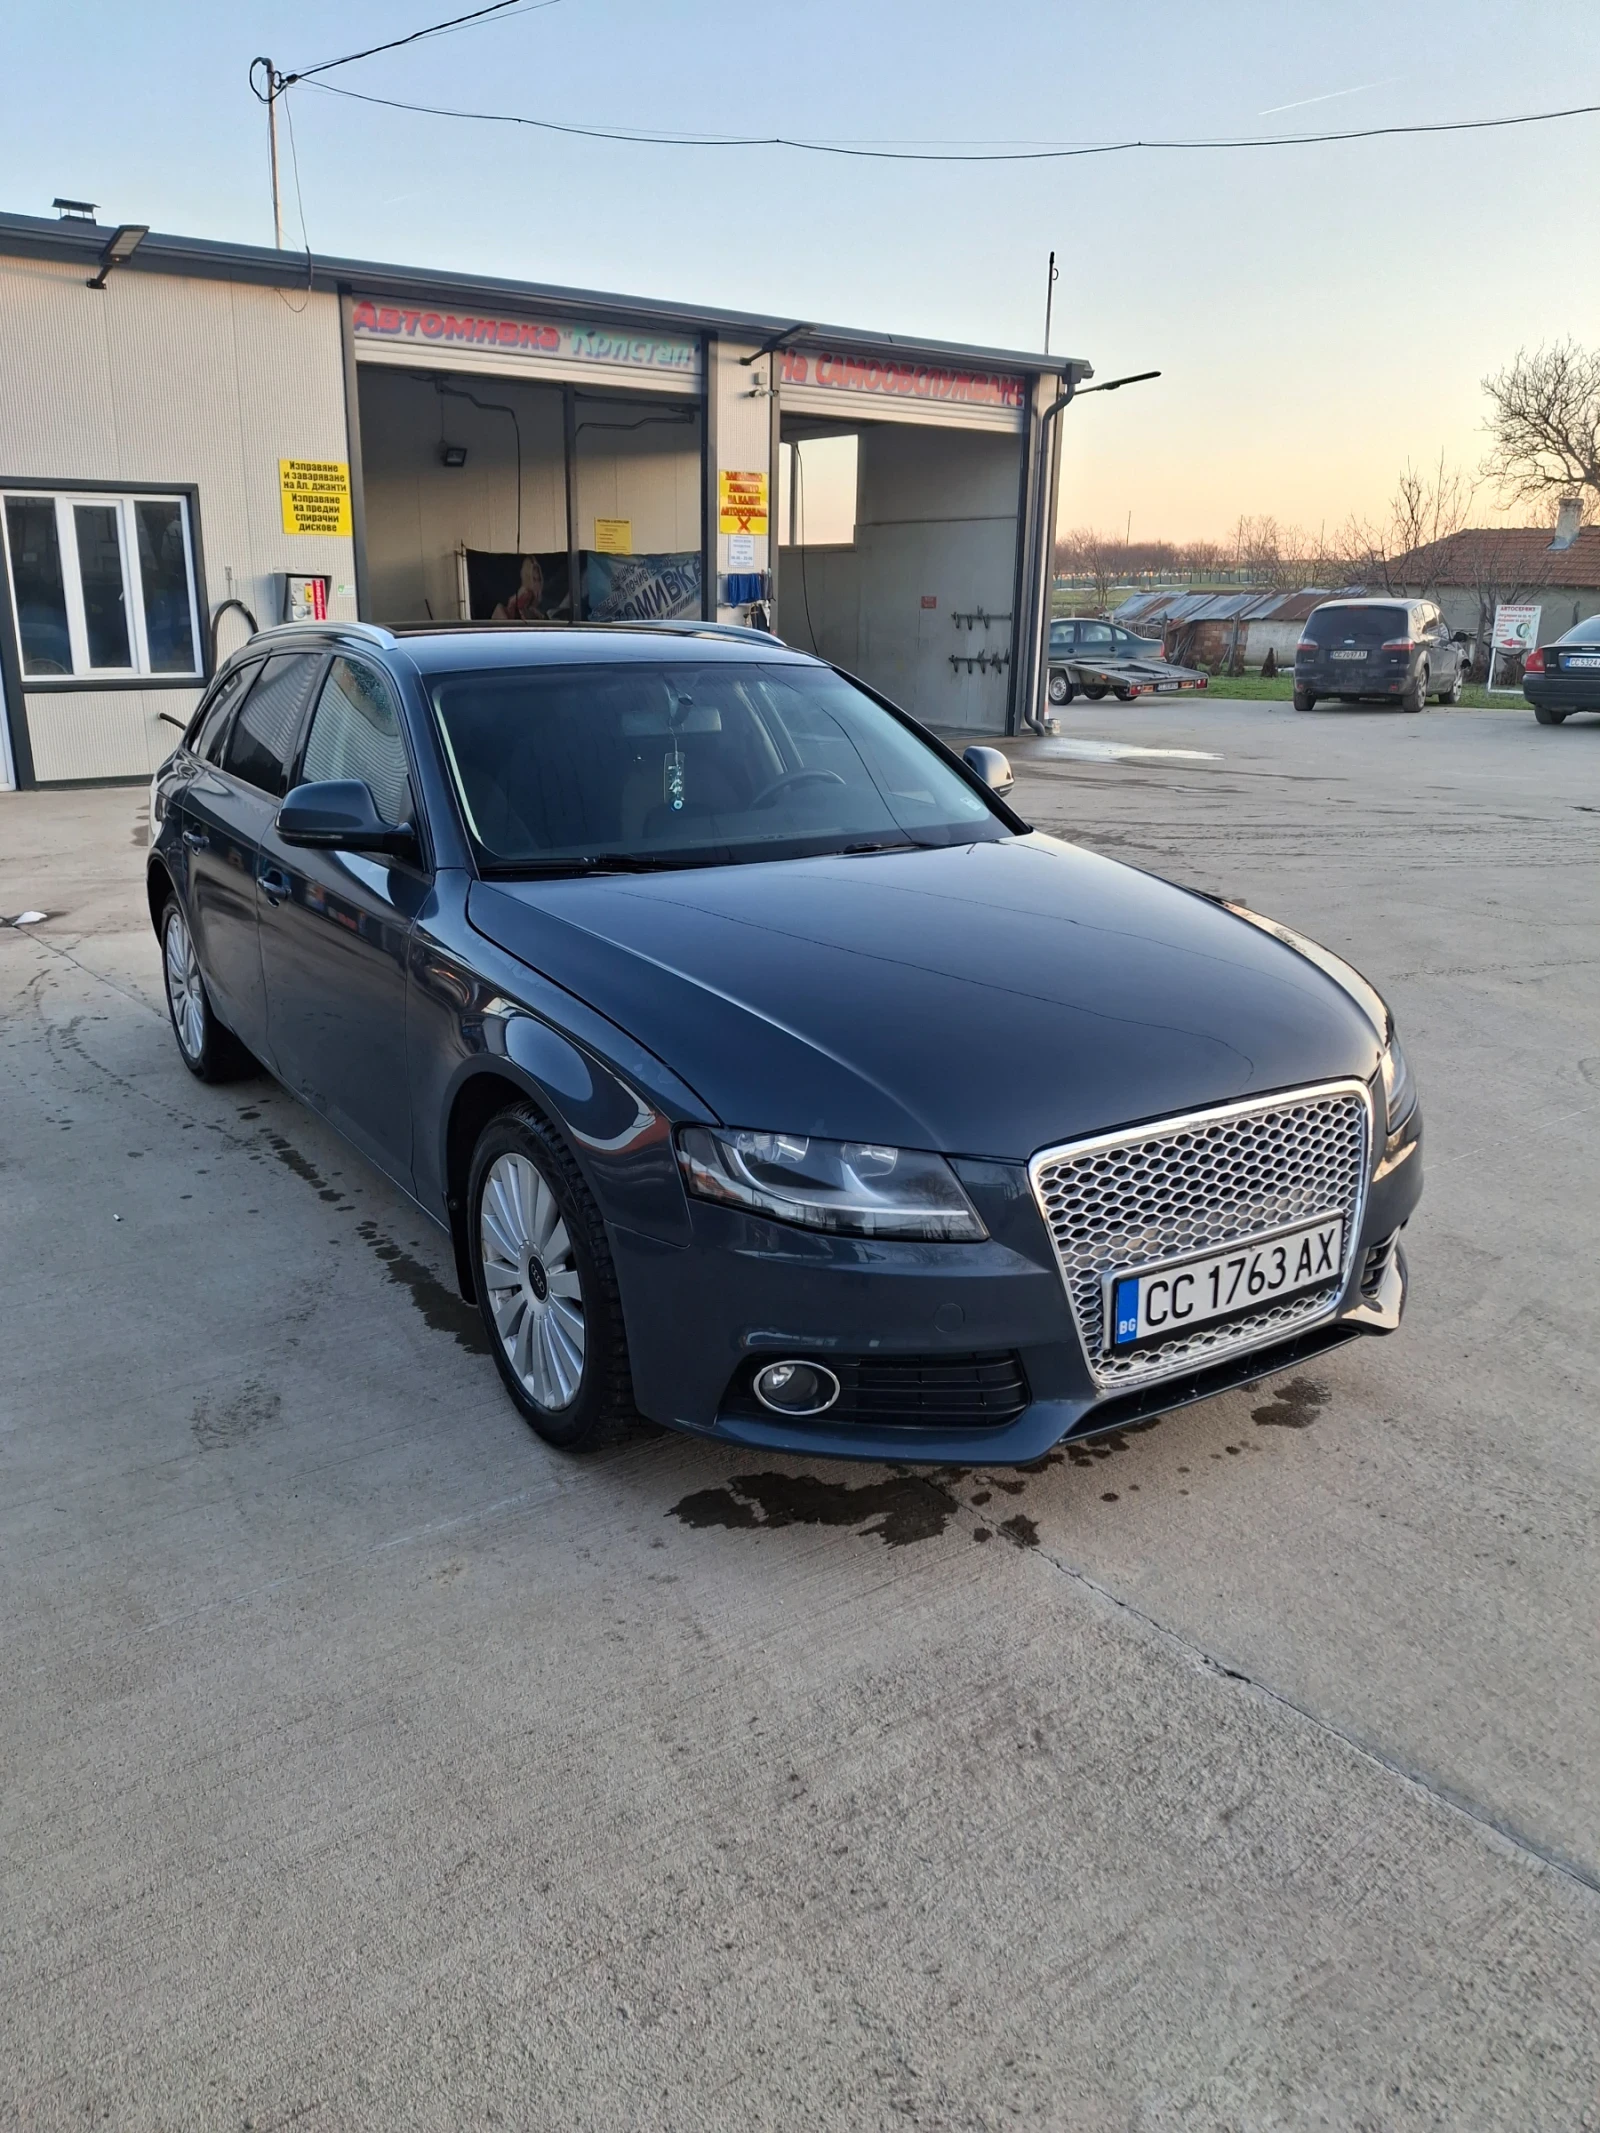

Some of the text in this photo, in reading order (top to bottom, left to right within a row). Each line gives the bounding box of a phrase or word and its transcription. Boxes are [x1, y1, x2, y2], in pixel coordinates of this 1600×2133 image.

[289, 461, 338, 472] Изправяне
[292, 473, 345, 482] заваряване
[284, 481, 294, 489] на
[312, 483, 346, 492] джанти
[291, 493, 340, 504] Изправяне
[293, 504, 340, 513] на предни
[295, 513, 339, 522] спирачни
[299, 523, 337, 532] дискове
[1119, 1228, 1337, 1335] BG CC 1763 AX
